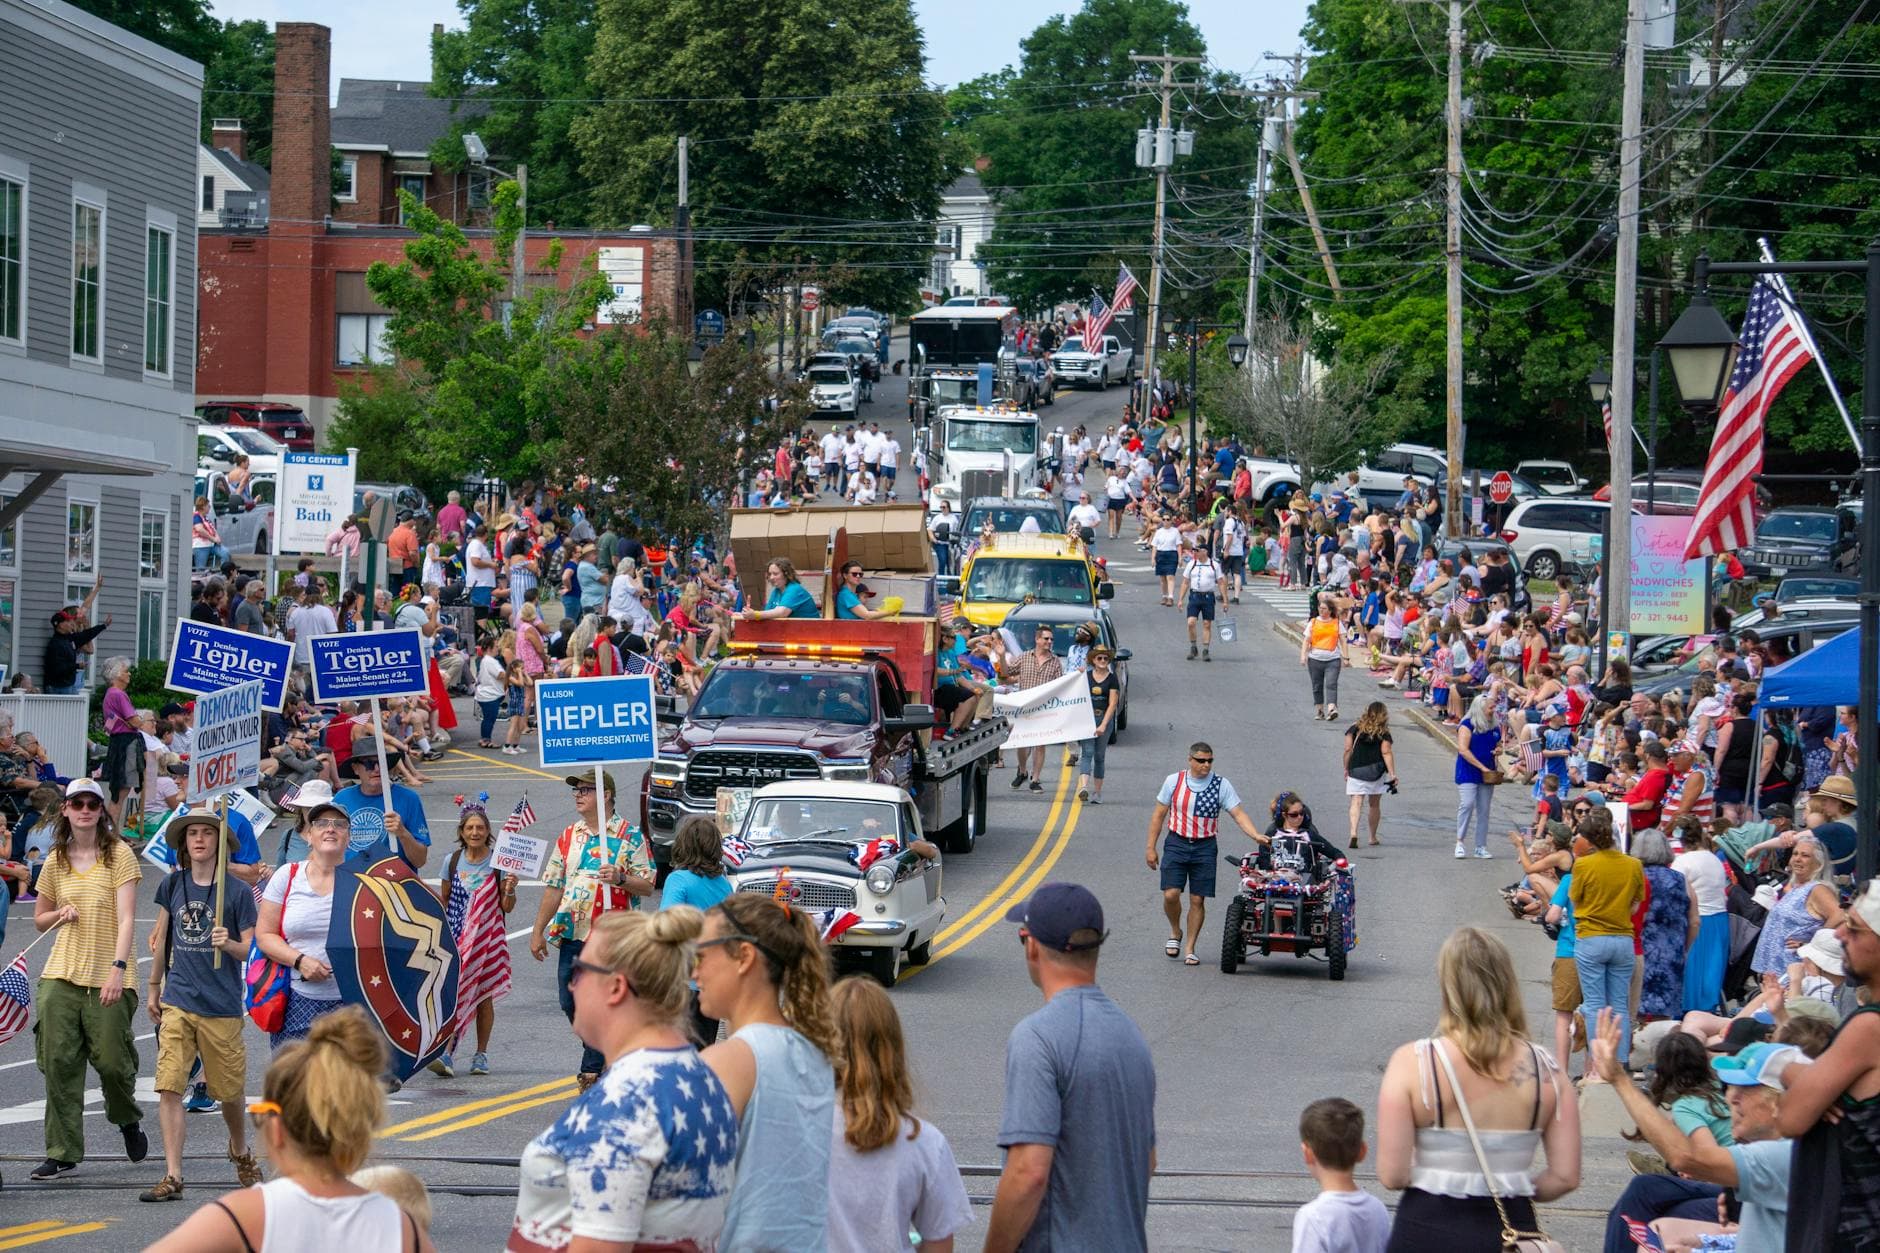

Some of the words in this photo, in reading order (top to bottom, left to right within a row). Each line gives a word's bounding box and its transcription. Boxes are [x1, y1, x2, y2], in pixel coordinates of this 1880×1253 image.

[308, 456, 343, 465] CENTRE
[1491, 481, 1511, 494] STOP
[296, 507, 331, 521] Bath
[1631, 577, 1694, 588] ANDWICHES
[1631, 613, 1640, 621] 07
[187, 627, 210, 637] VOTE
[213, 641, 239, 652] Denise
[318, 640, 340, 648] VOTE
[346, 646, 371, 654] Denise
[189, 639, 277, 676] Tepler
[324, 647, 412, 673] Tepler
[192, 666, 218, 678] Maine
[335, 675, 361, 683] Maine
[362, 673, 389, 681] Senate
[543, 690, 574, 699] ALLISON
[200, 685, 259, 728] DEMOCRACY
[544, 702, 649, 731] HEPLER
[198, 725, 225, 751] COUNTS
[227, 720, 237, 741] ON
[240, 716, 259, 738] YOUR
[545, 738, 573, 748] STATE
[574, 733, 650, 746] REPRESENTATIVE
[196, 752, 237, 793] VOTE!
[726, 767, 781, 777] RAM
[500, 846, 517, 857] COUNTS
[497, 855, 523, 870] VOTE!
